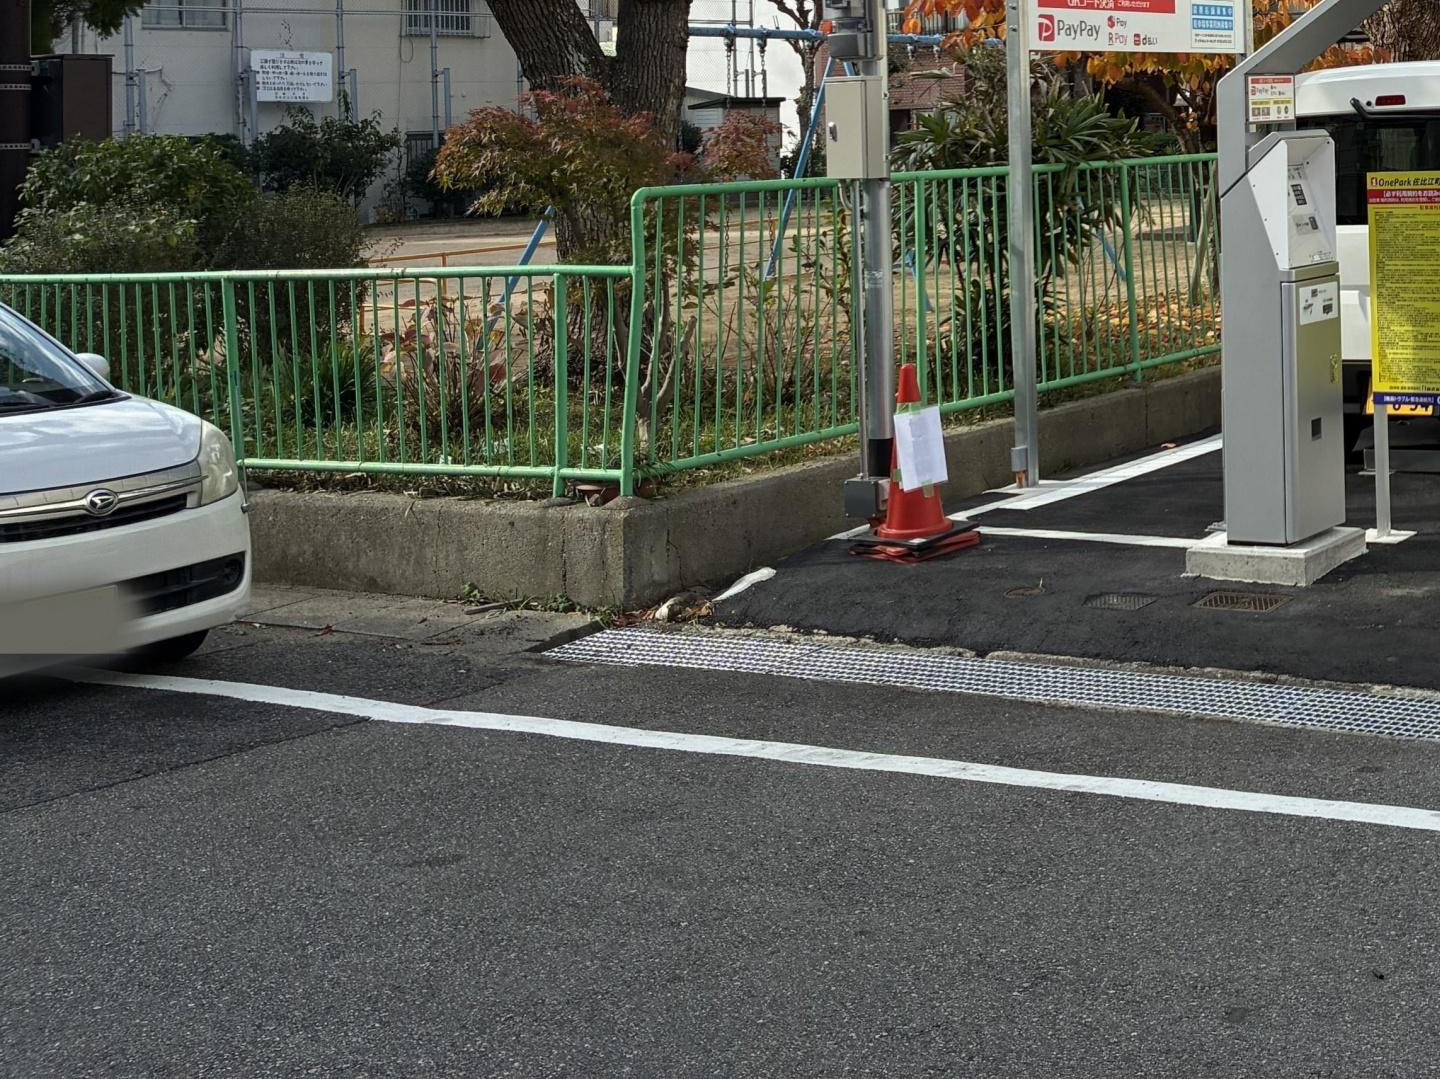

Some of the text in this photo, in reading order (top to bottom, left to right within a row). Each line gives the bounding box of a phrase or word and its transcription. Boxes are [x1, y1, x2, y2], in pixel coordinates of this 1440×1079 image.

[1057, 19, 1101, 41] PayPay
[1116, 19, 1128, 29] Pay
[1114, 31, 1128, 46] Pay
[1378, 177, 1412, 187] OnePark
